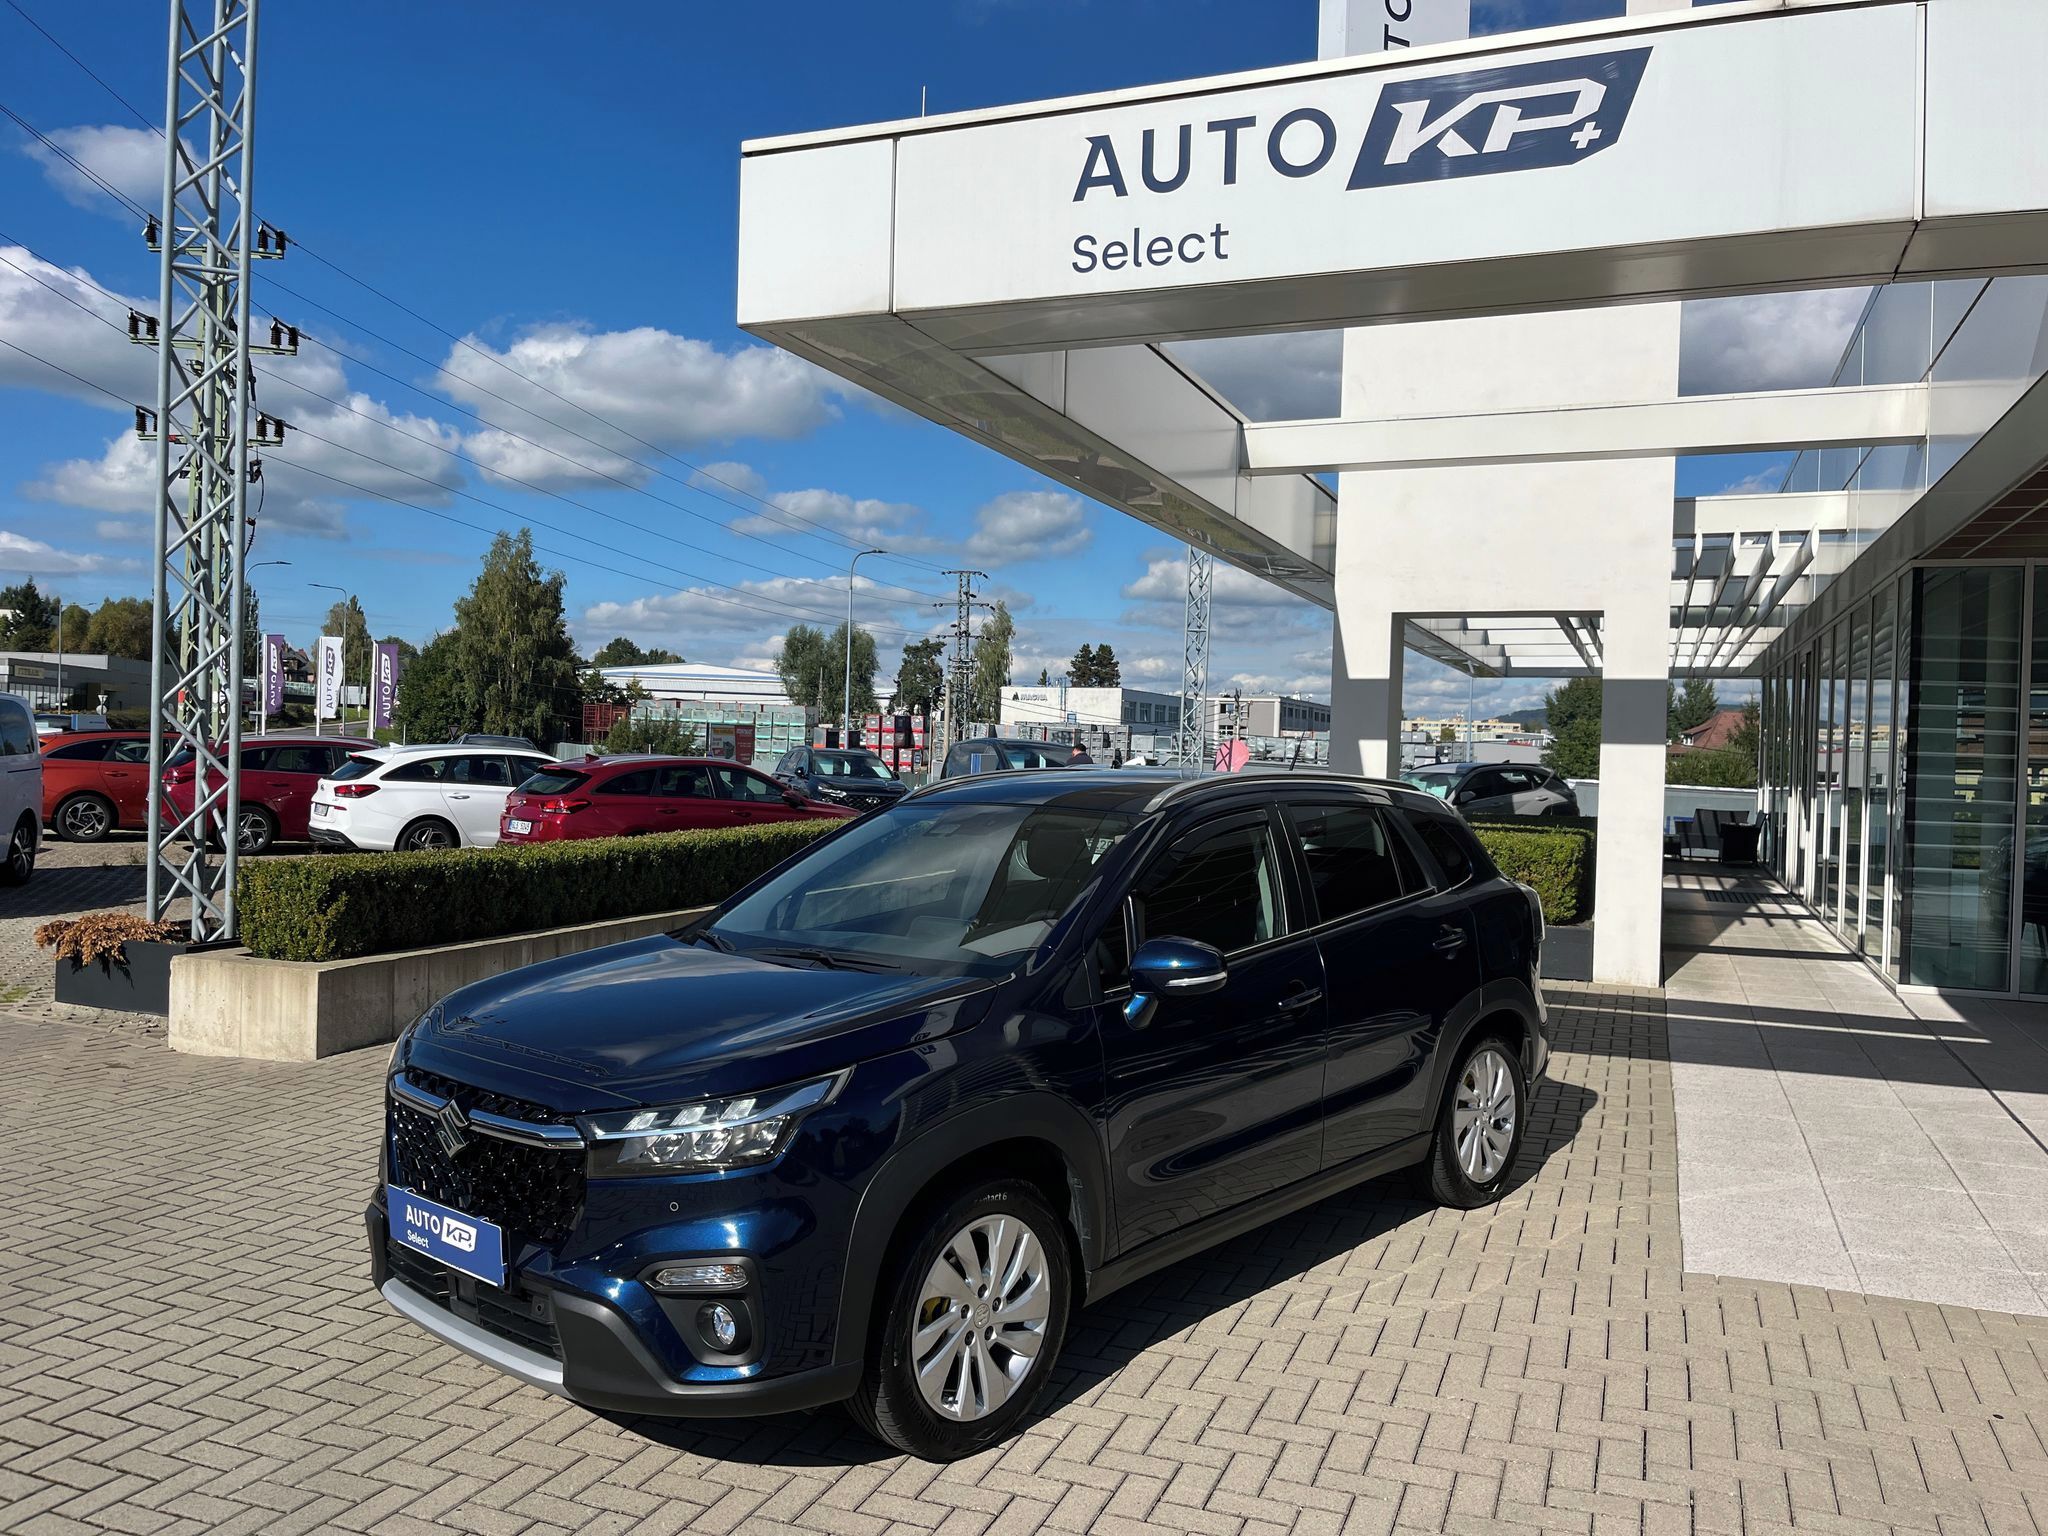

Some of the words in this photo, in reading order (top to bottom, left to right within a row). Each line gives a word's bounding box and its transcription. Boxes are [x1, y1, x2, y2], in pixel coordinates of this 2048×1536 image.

[1072, 107, 1337, 202] AUTO
[1072, 223, 1229, 273] Select
[382, 685, 391, 718] AUTO
[406, 1204, 440, 1234] AUTO
[407, 1229, 429, 1249] Select
